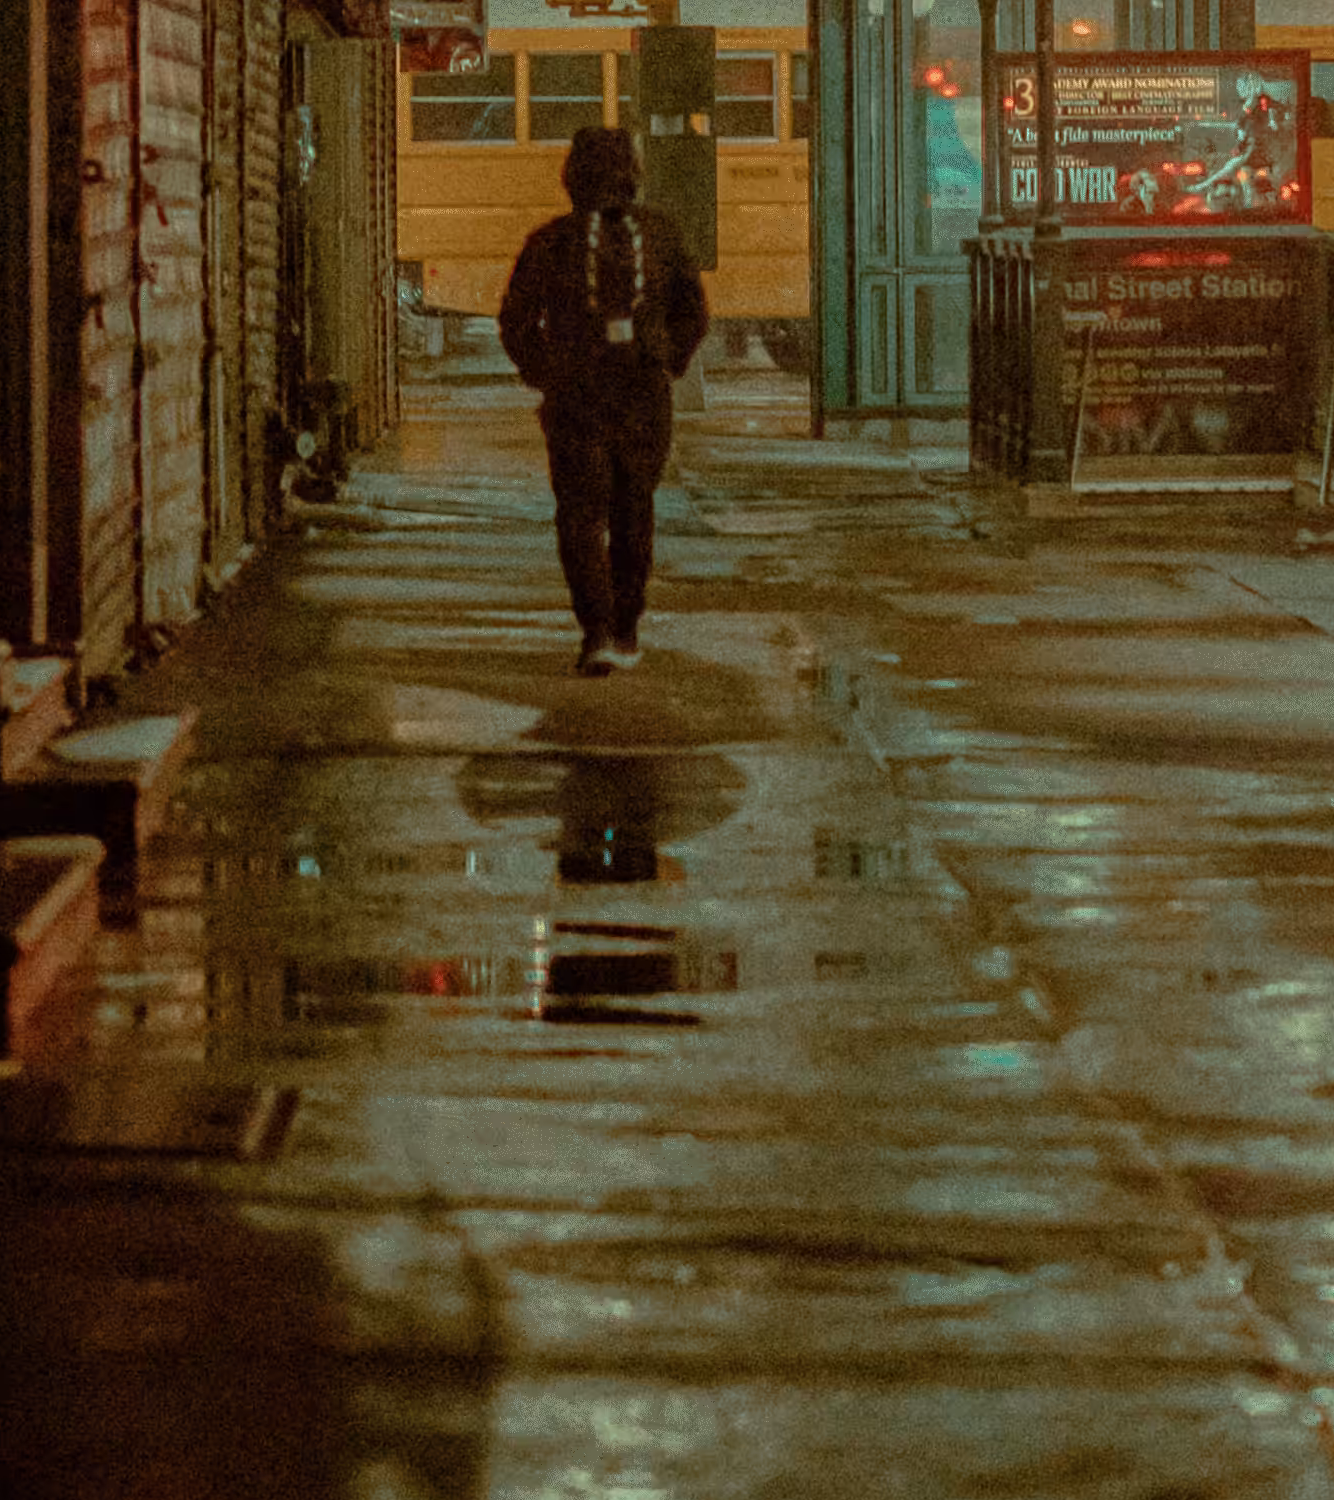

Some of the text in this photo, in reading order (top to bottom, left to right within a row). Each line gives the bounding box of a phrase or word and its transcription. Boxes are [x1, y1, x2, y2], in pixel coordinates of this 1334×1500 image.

[1014, 78, 1035, 116] 3
[1091, 78, 1133, 89] AWARD
[1134, 78, 1215, 89] NOMINATIONS
[1066, 105, 1117, 115] FOREIGN
[1121, 105, 1183, 115] LANGUAGE
[1187, 105, 1216, 115] FILM
[1011, 166, 1118, 204] COD WAR
[1107, 274, 1193, 301] Street
[1201, 273, 1304, 300] Station
